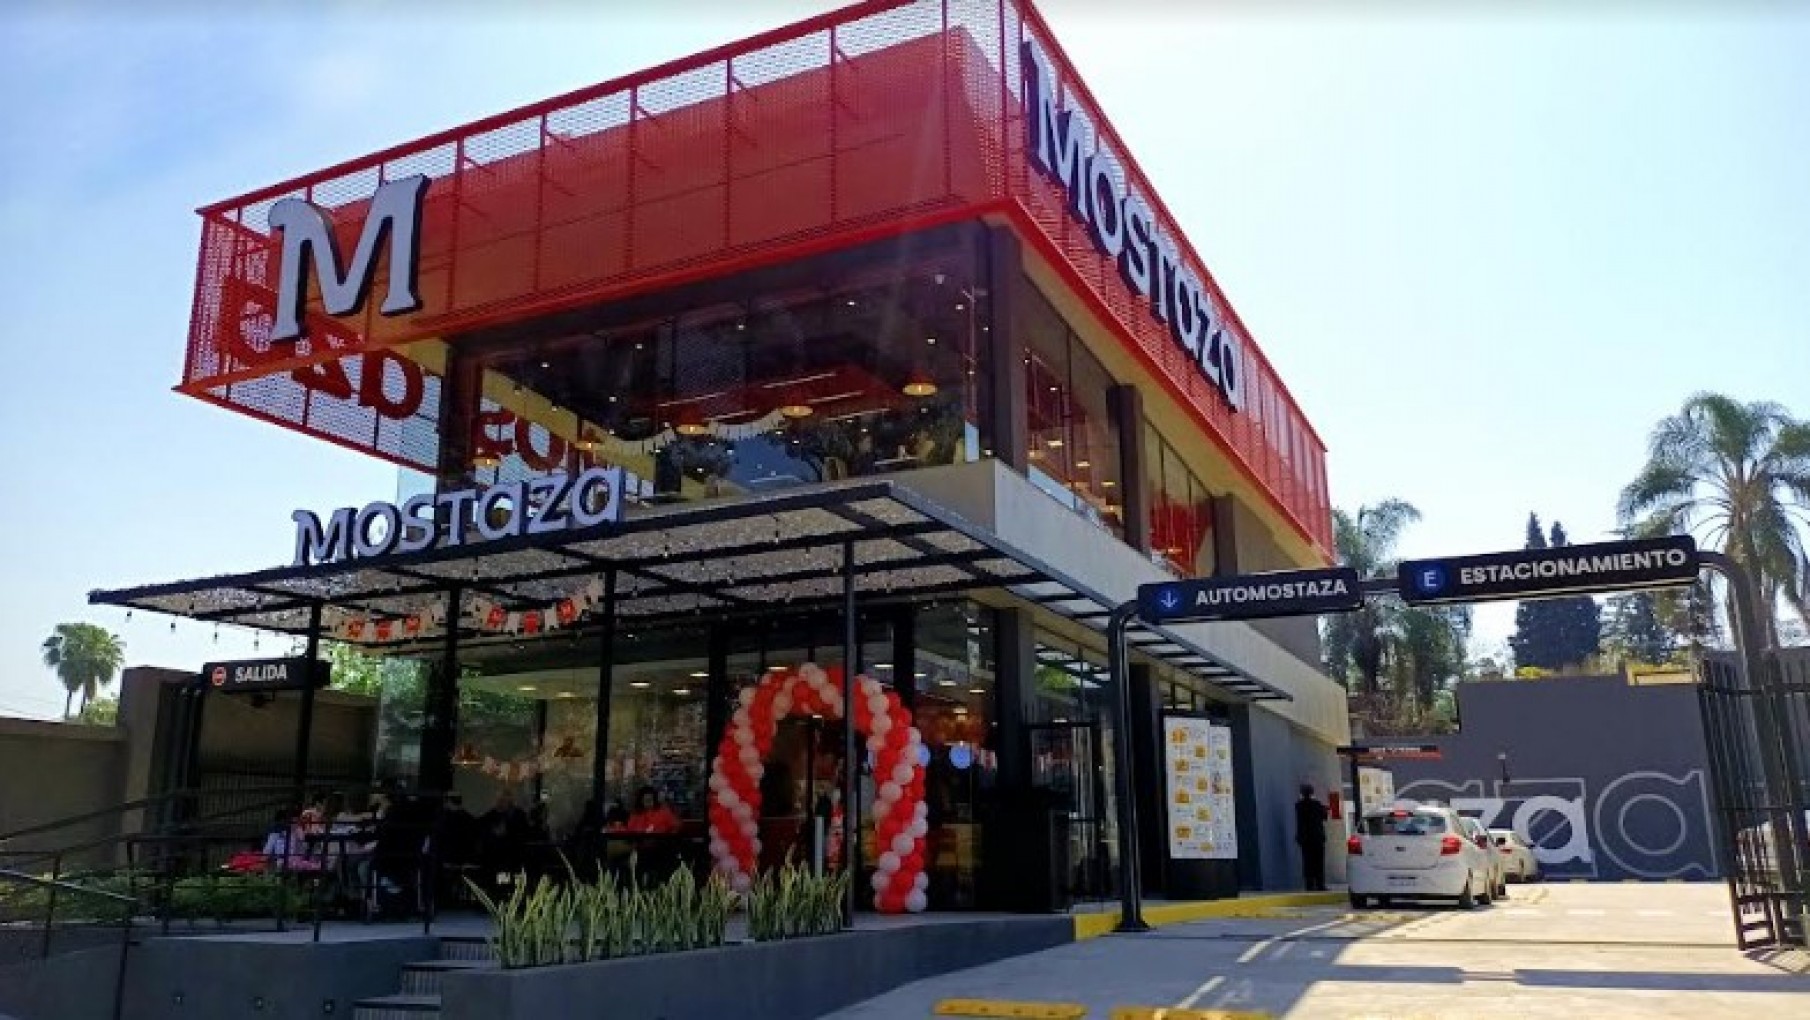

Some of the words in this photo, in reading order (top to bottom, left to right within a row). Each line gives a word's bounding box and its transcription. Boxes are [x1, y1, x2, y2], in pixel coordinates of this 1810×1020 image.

[267, 175, 430, 341] M
[1423, 570, 1437, 587] E
[1460, 549, 1687, 585] ESTACIONAMIENTO
[1195, 578, 1349, 606] AUTOMOSTAZA
[234, 664, 288, 683] SALIDA
